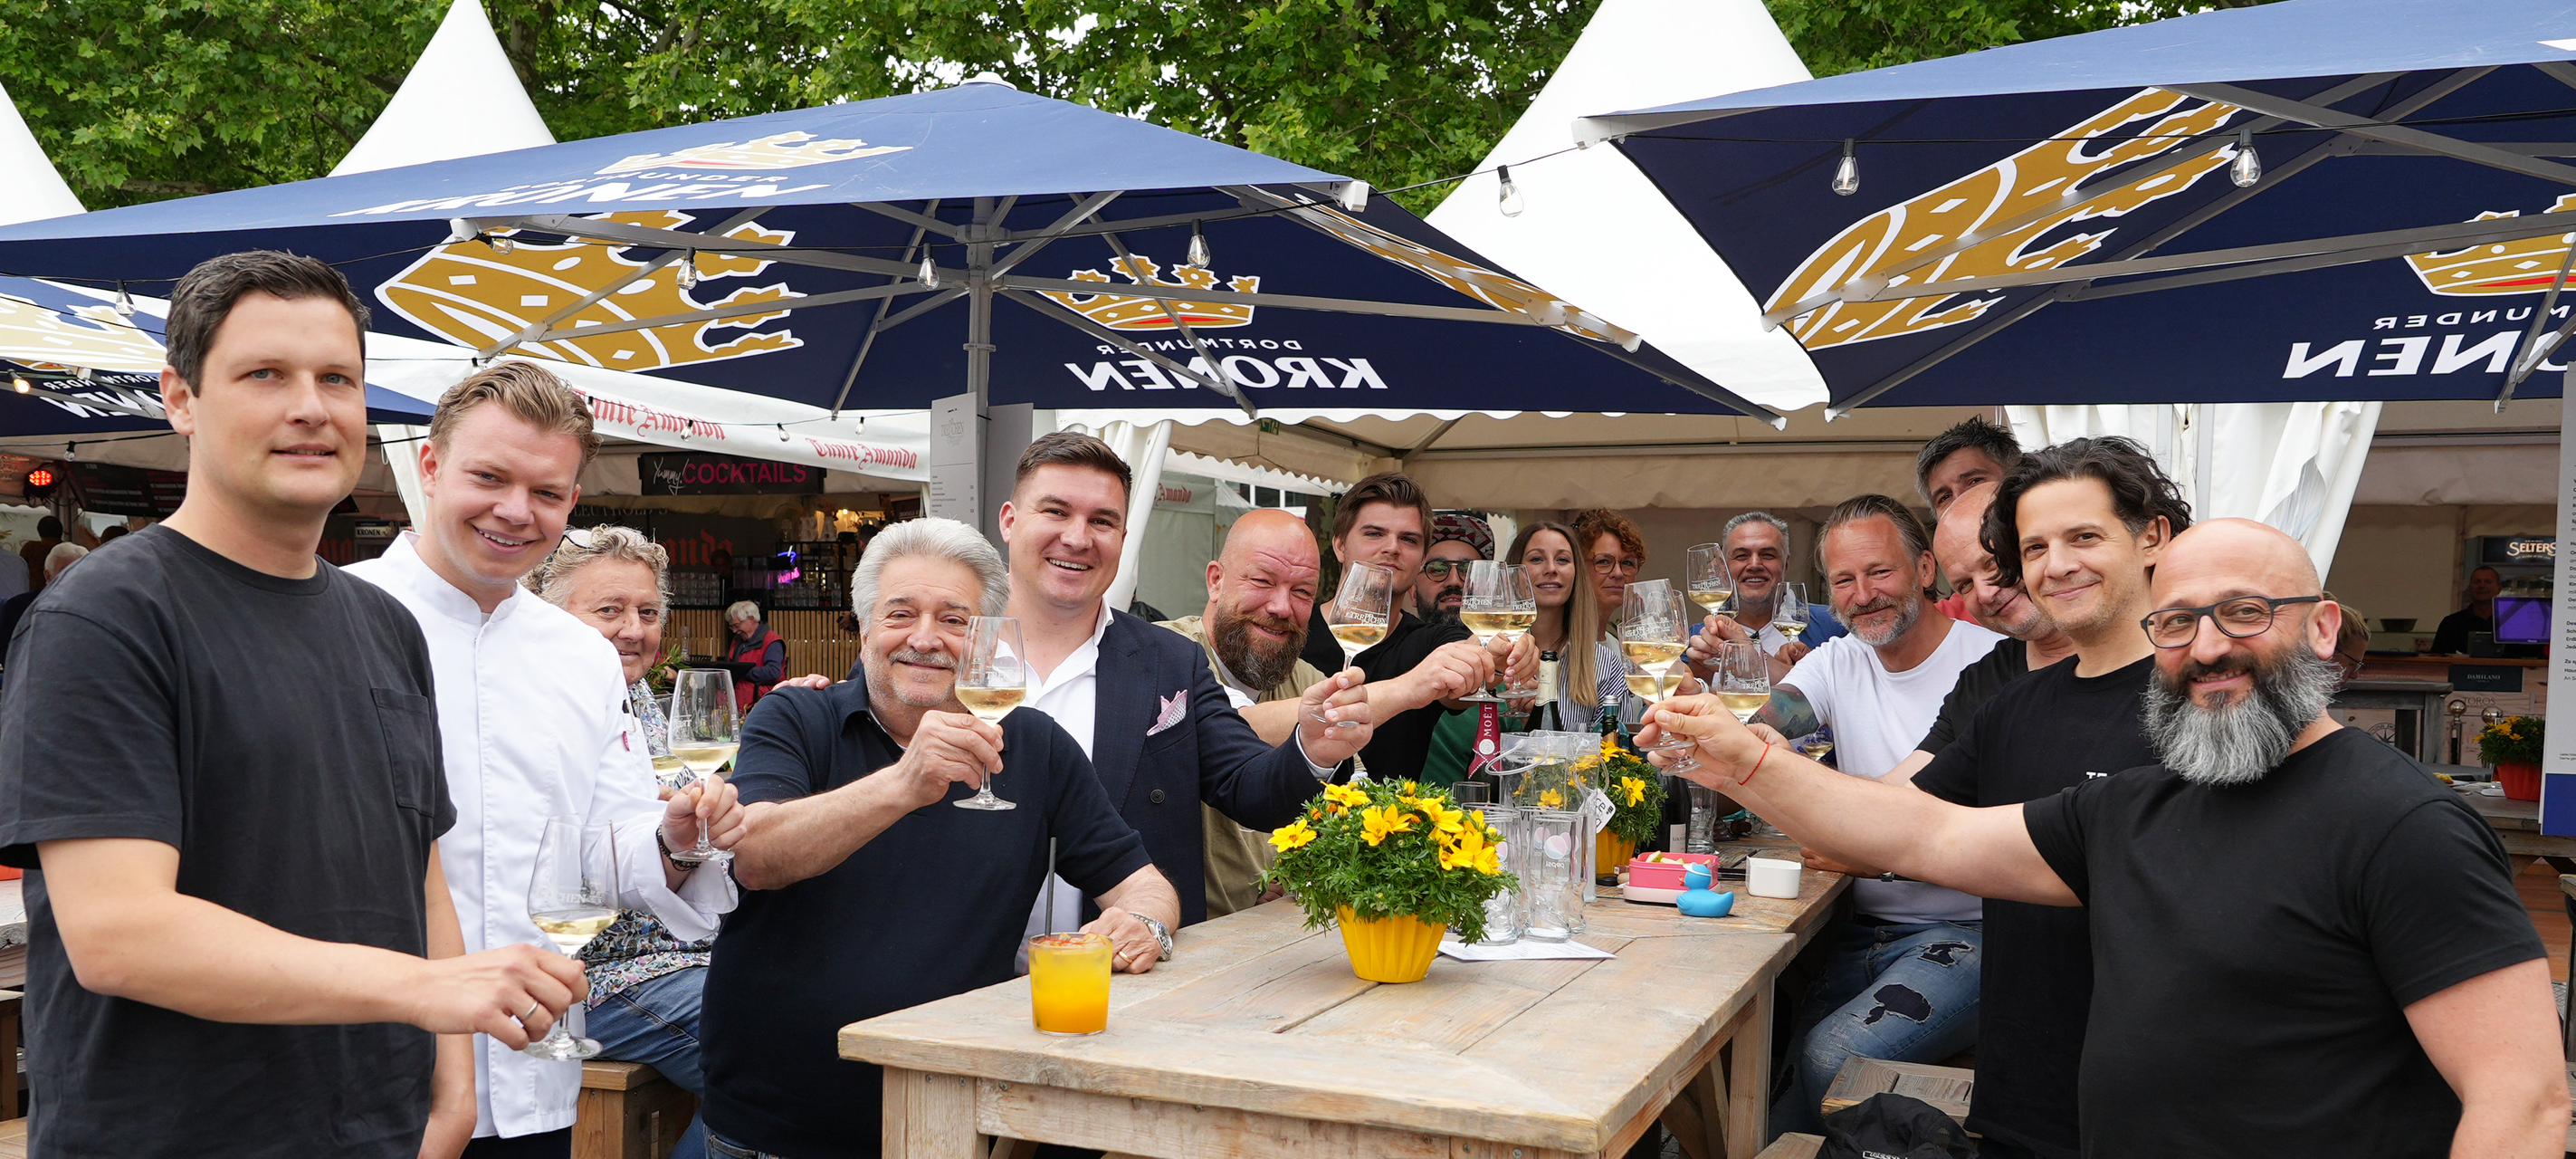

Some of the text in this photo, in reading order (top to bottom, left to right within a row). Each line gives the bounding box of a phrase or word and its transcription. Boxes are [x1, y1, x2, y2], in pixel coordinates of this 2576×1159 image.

[805, 437, 918, 470] Tante Amanda
[654, 456, 806, 496] Yummy! COCKTAILS
[2463, 696, 2496, 705] TOROS
